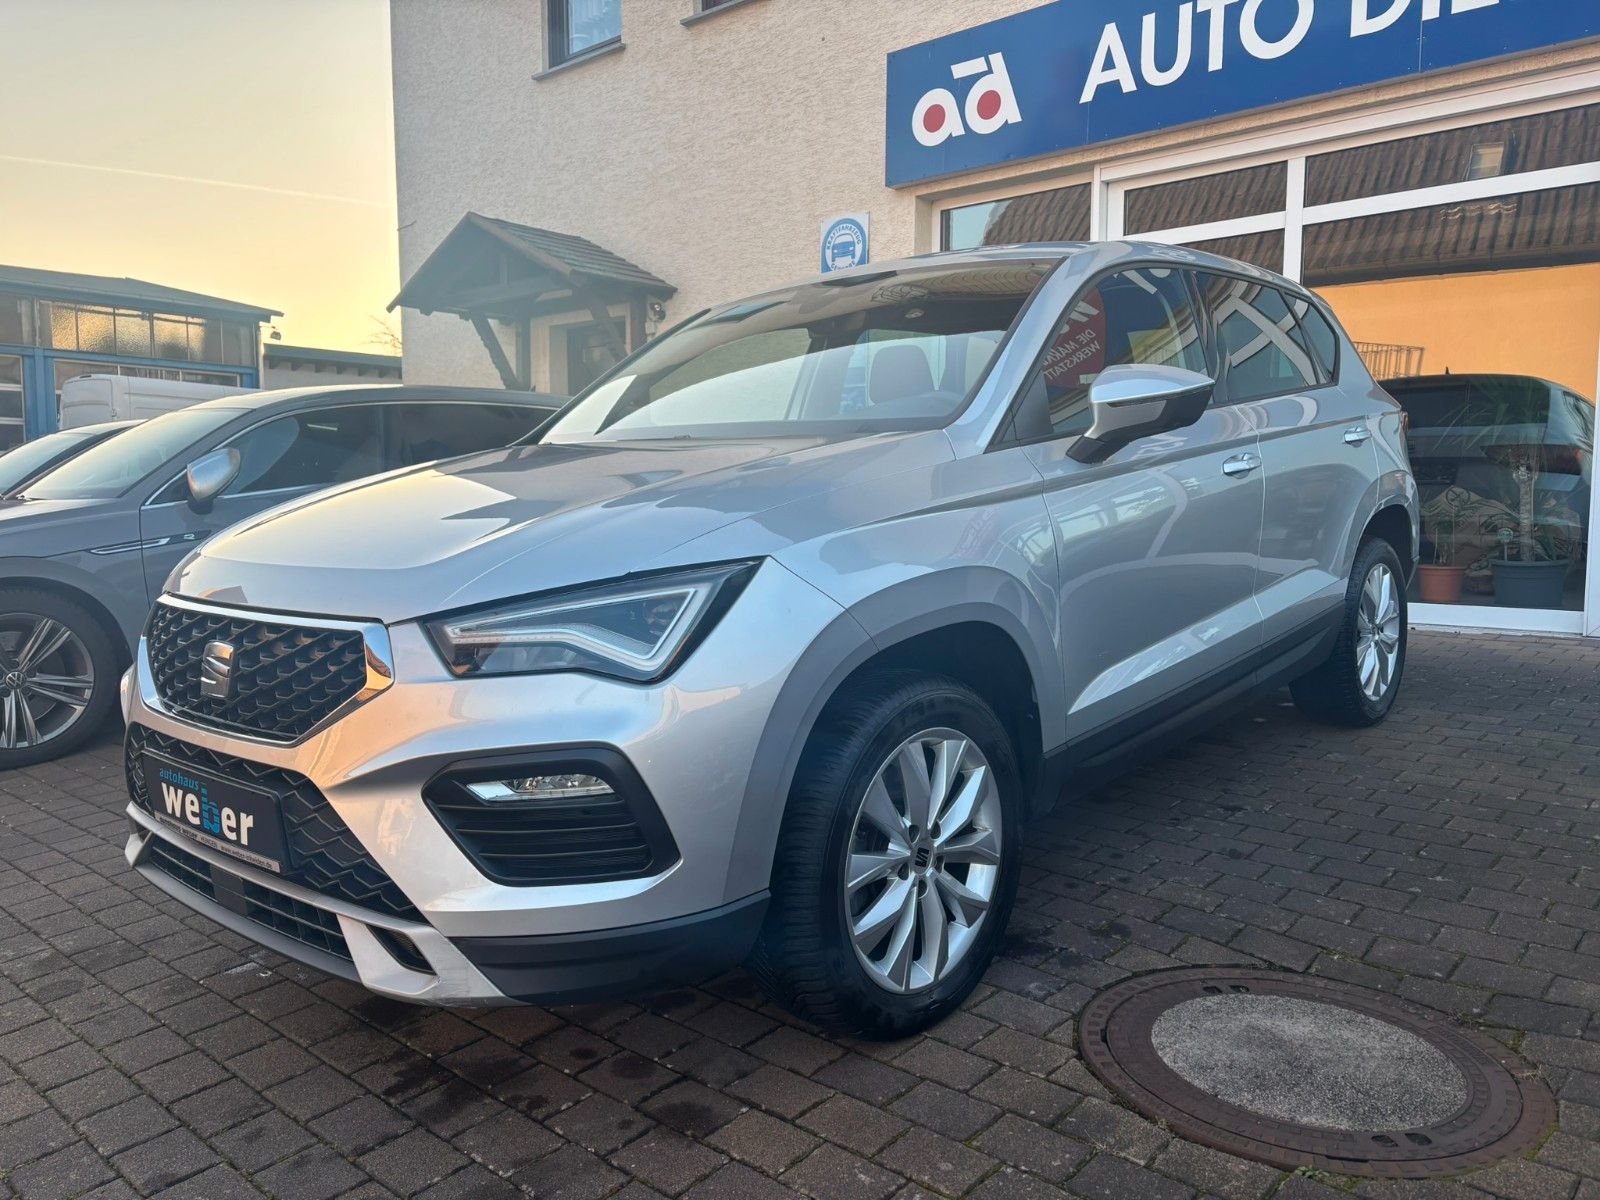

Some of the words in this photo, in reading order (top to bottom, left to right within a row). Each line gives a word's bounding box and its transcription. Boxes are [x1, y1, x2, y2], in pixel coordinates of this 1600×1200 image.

[1079, 0, 1315, 104] AUTO
[826, 224, 862, 250] KRAFTFAHRZEUG
[159, 768, 199, 791] autohaus
[161, 782, 254, 846] weber
